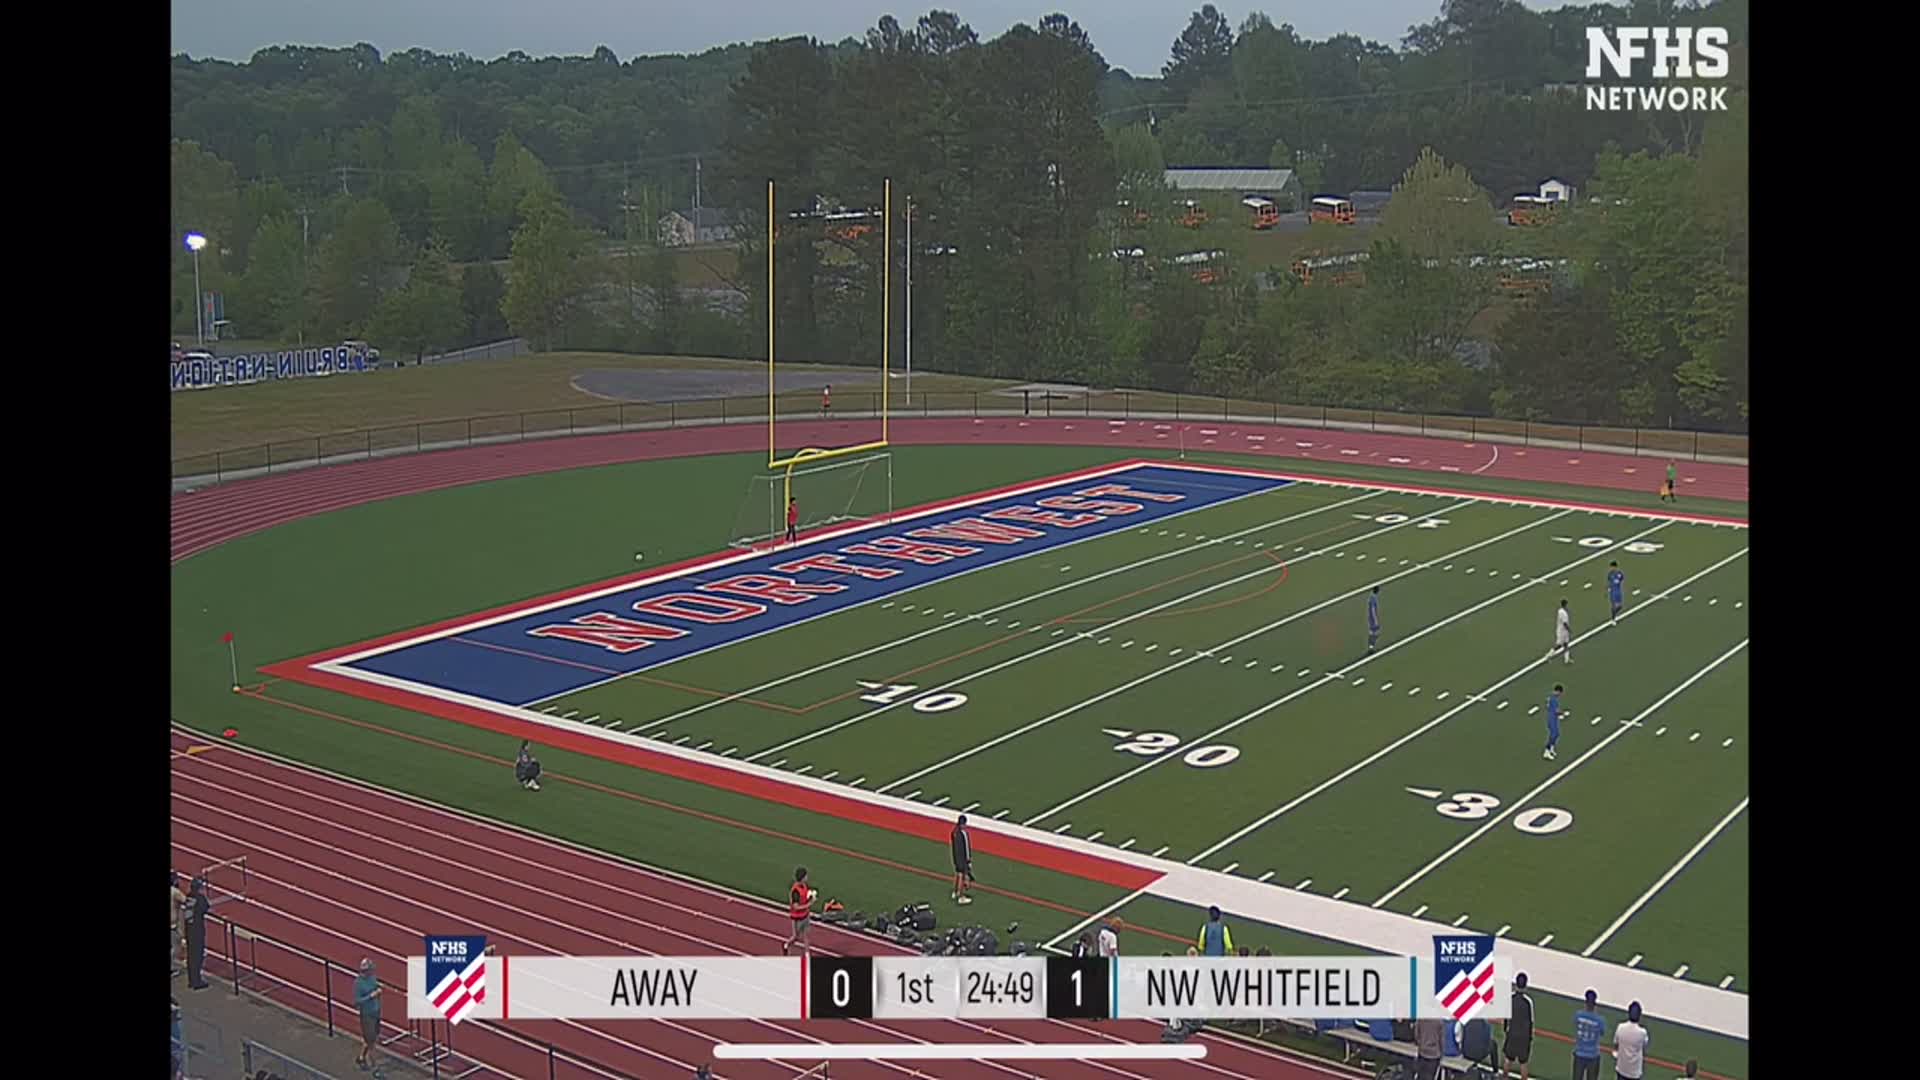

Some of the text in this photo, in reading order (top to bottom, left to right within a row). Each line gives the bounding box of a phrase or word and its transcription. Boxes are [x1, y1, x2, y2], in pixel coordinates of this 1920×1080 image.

[526, 482, 1187, 654] NORTHWEST
[859, 683, 969, 713] 10
[1112, 731, 1241, 767] 20
[1436, 792, 1574, 834] 30
